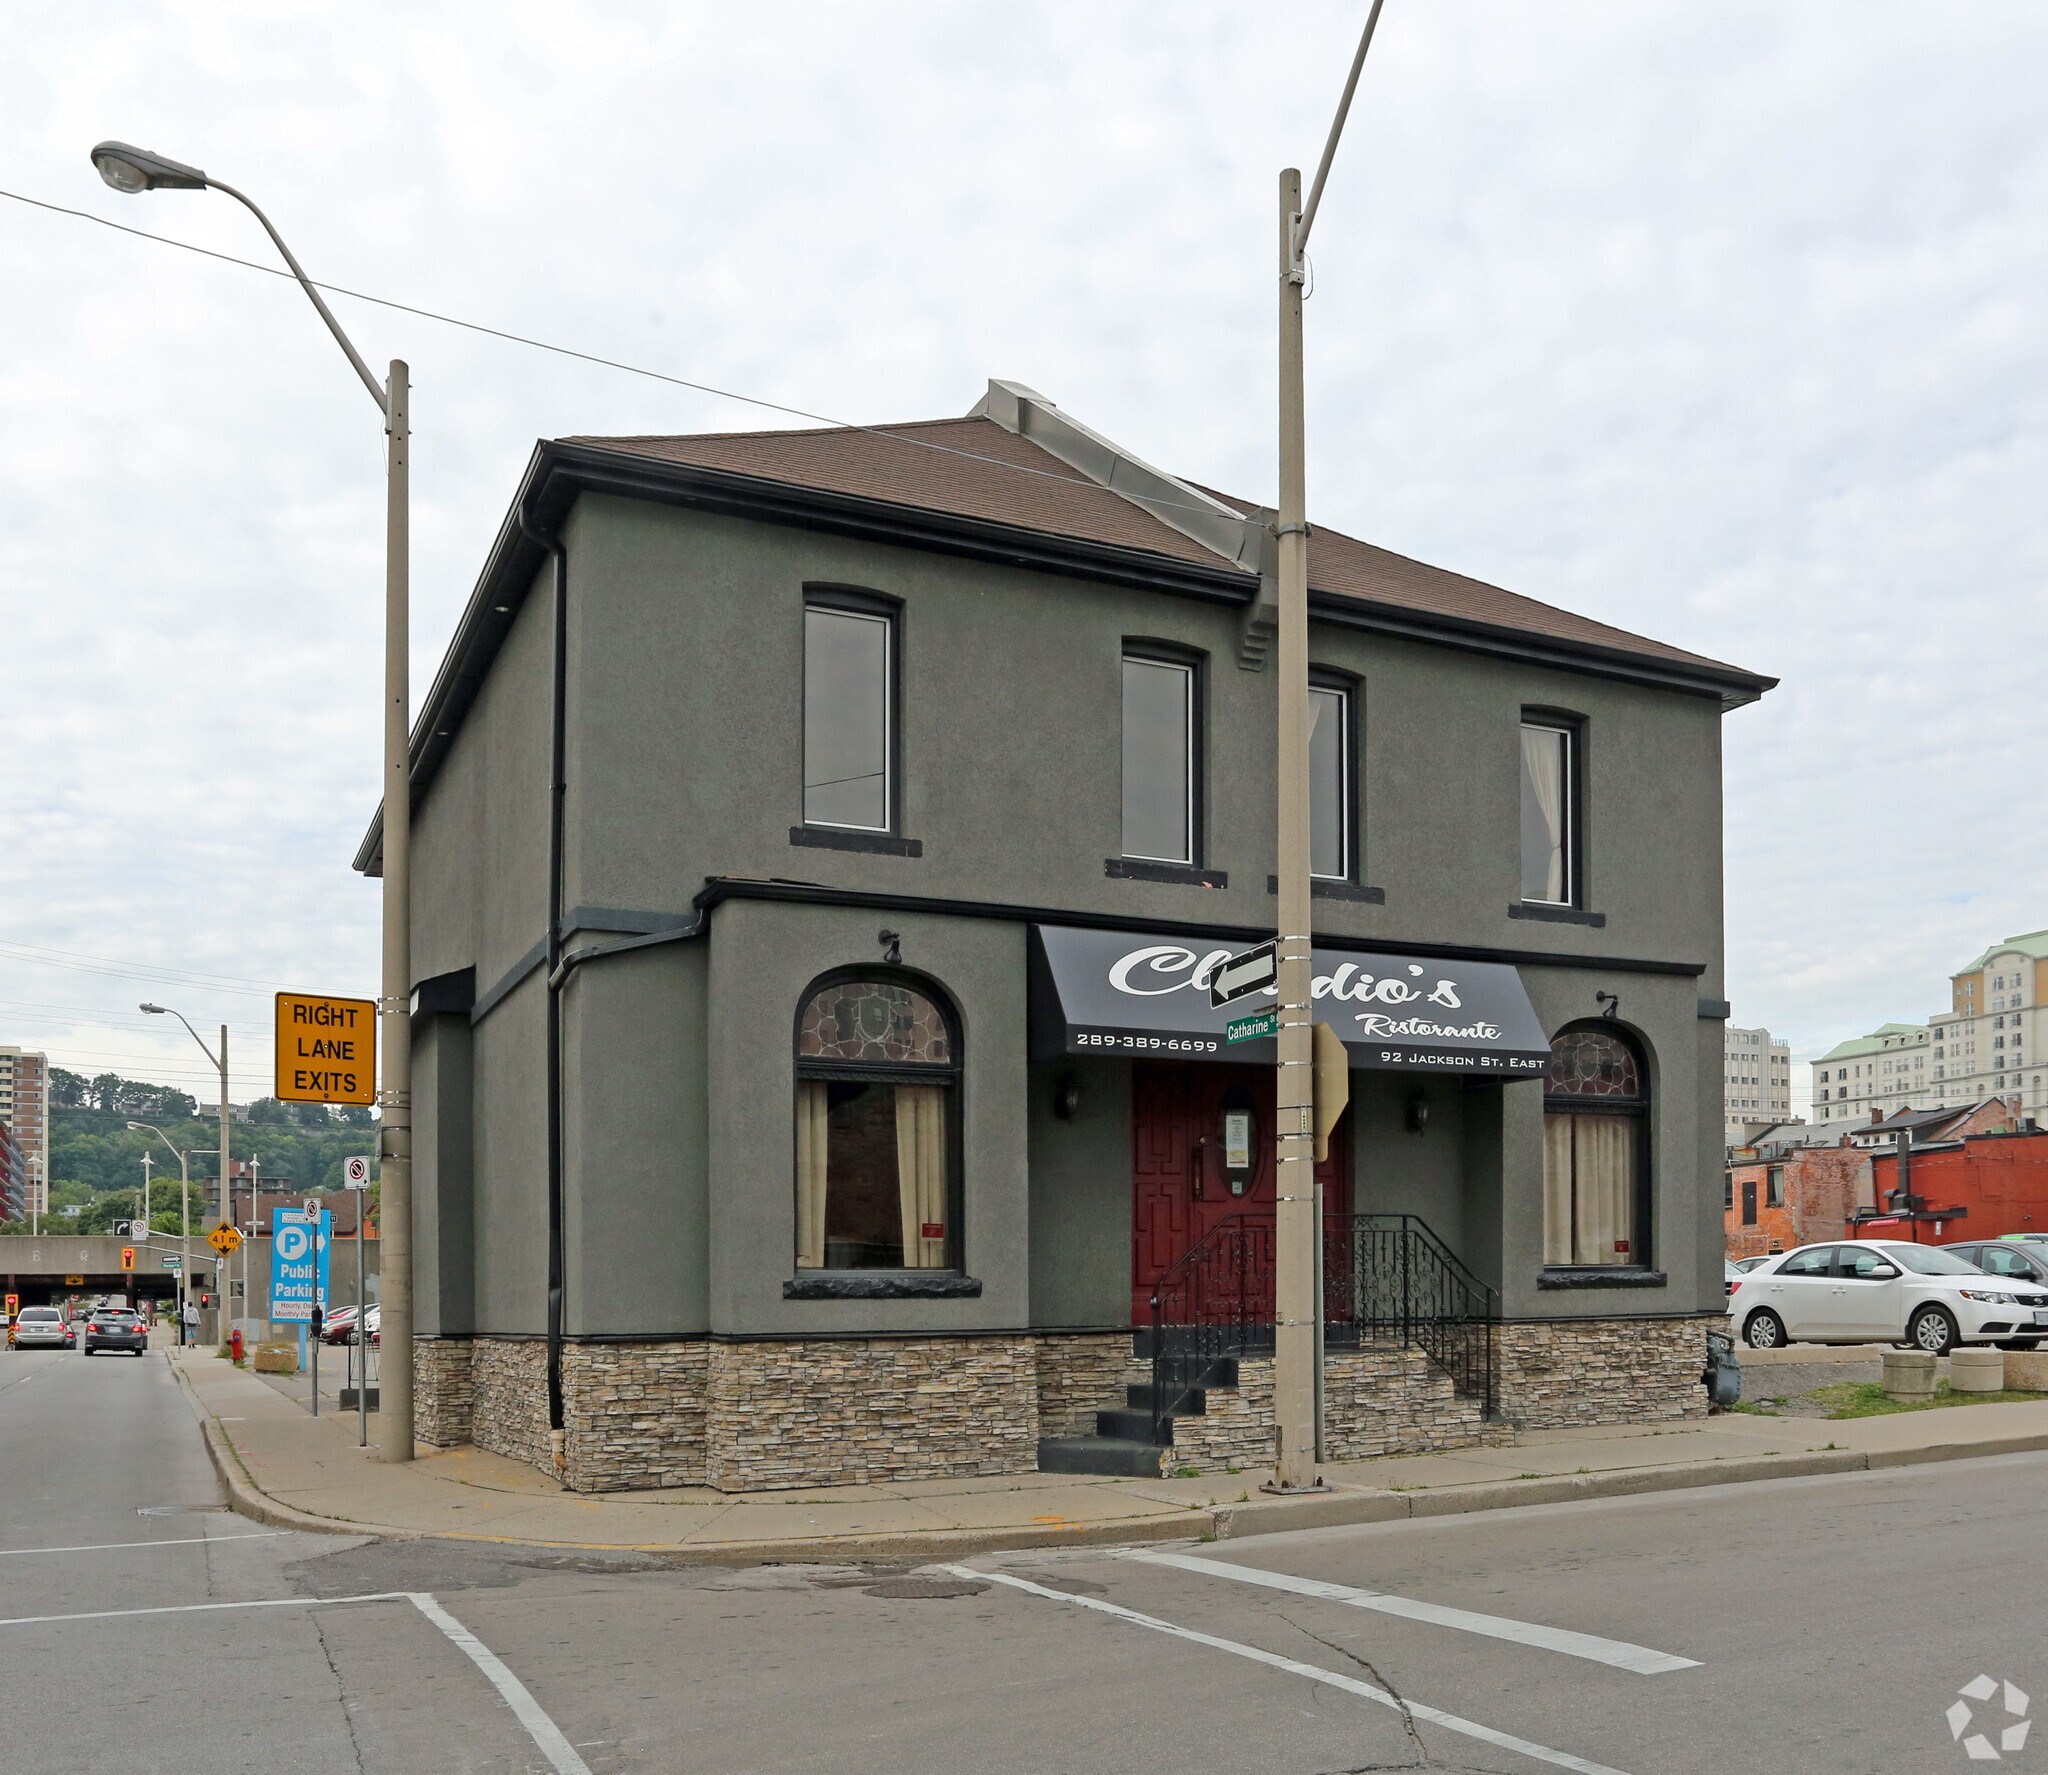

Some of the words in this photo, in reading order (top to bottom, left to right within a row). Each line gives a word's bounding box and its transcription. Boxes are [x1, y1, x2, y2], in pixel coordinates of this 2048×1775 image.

[1108, 945, 1462, 1009] Cldio's
[293, 1004, 358, 1028] RIGHT
[1354, 1013, 1503, 1040] Ristorante
[1228, 1019, 1268, 1040] Catharine
[297, 1037, 355, 1060] LANE
[1076, 1033, 1218, 1052] 289-389-6699
[1380, 1051, 1402, 1063] 92
[294, 1070, 357, 1093] EXITS
[275, 1282, 325, 1301] Parkig
